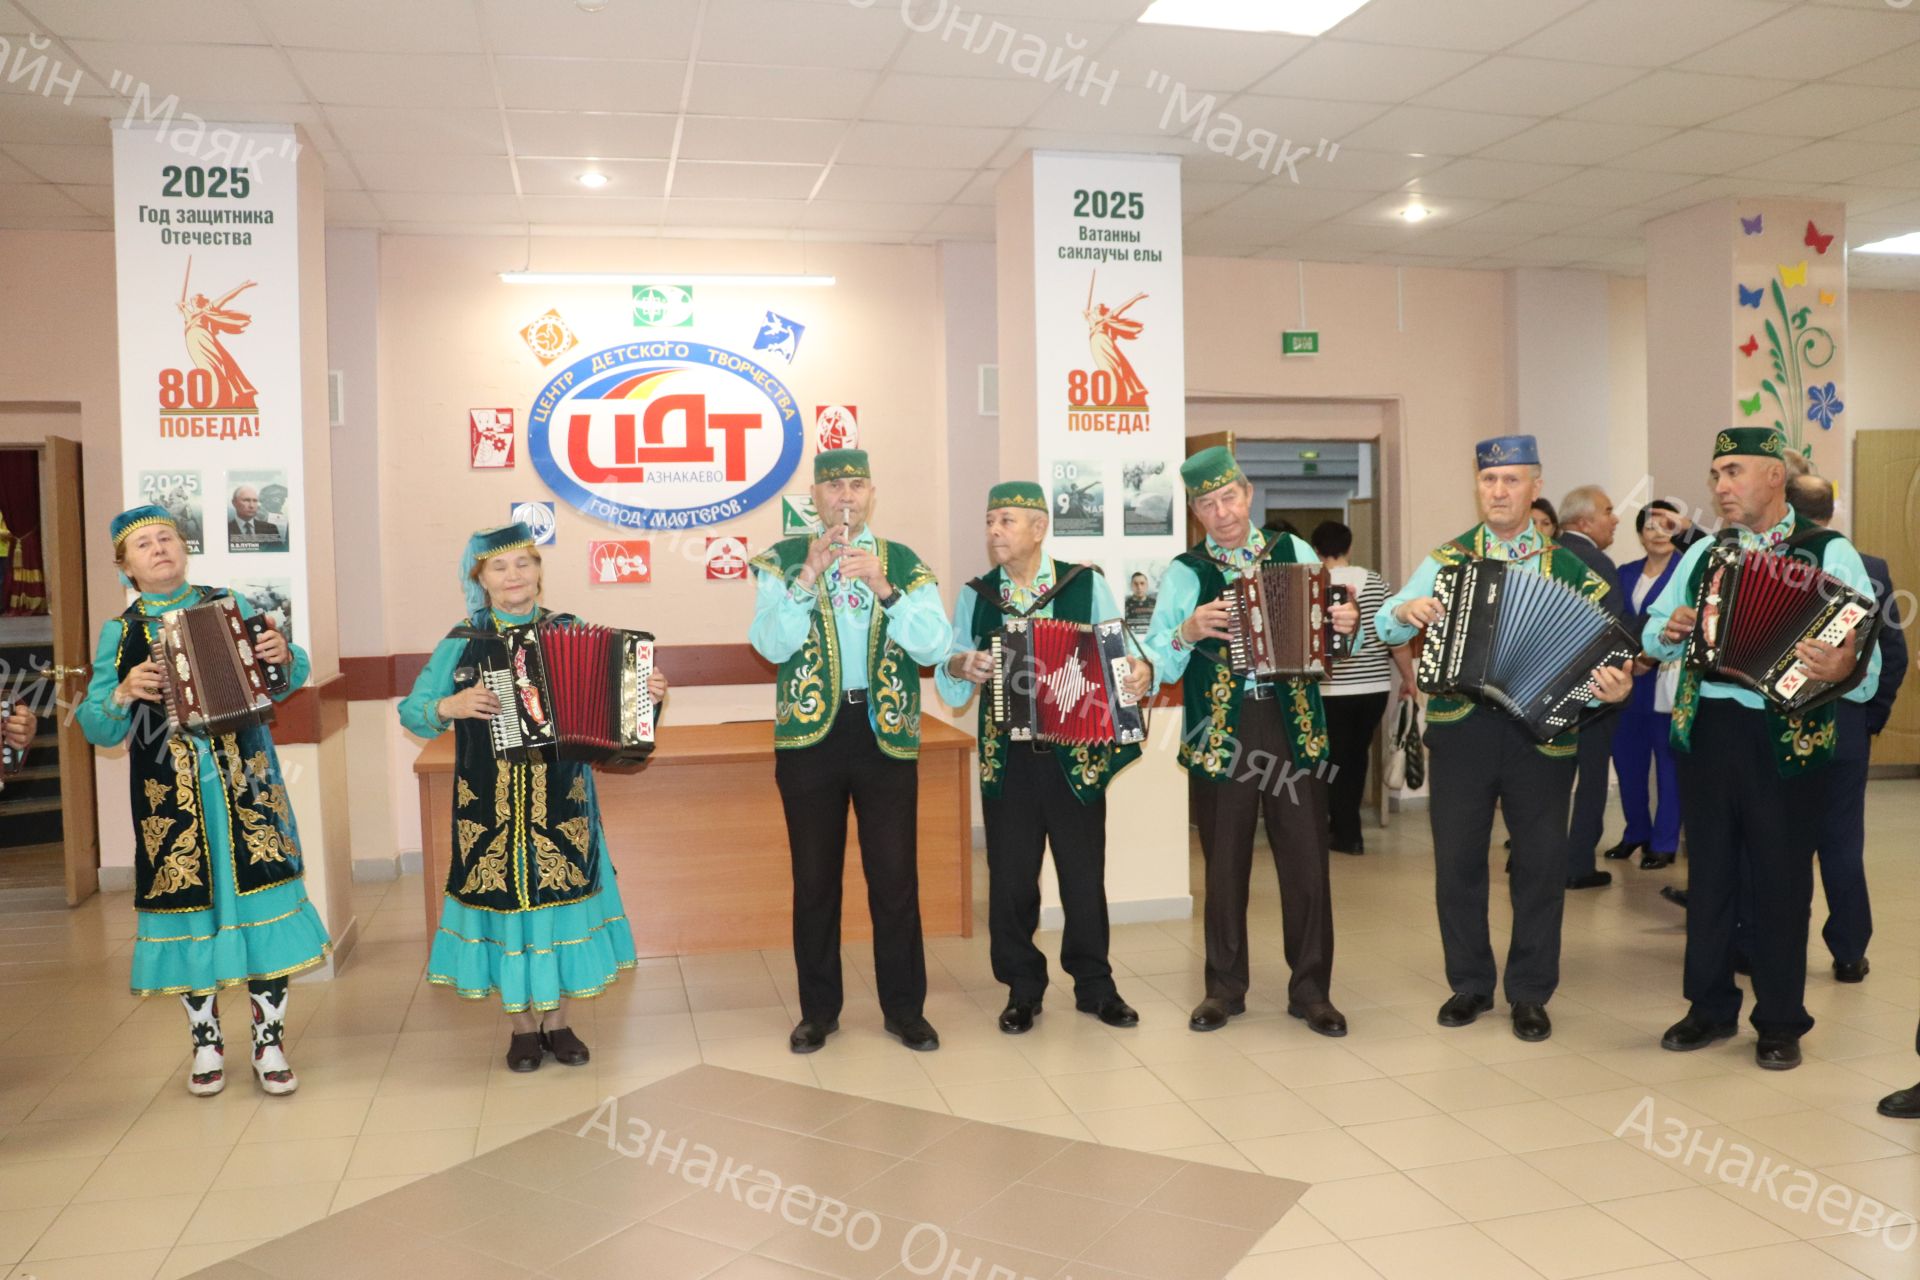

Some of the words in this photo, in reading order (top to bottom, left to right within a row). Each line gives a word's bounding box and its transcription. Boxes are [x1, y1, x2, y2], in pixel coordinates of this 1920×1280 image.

[162, 165, 250, 198] 2025
[1073, 189, 1144, 220] 2025
[139, 205, 170, 227] Год
[176, 207, 274, 225] защитника
[161, 227, 252, 247] Отечества
[1079, 225, 1141, 243] Ватанны
[1058, 246, 1129, 263] саклаучы
[1133, 248, 1162, 262] елы
[158, 368, 213, 409] 80
[534, 371, 575, 423] ЦЕНТР
[591, 342, 689, 373] ДЕТСКОГО
[708, 349, 796, 421] ТВОРЧЕСТВА
[1067, 369, 1112, 406] 80
[159, 416, 261, 441] ПОБЕДА!
[1068, 413, 1150, 435] ПОБЕДА!
[567, 394, 762, 483] ЦДТ
[646, 470, 723, 484] АЗНАКАЕВО
[1055, 464, 1077, 479] 80
[143, 474, 198, 492] 2025
[590, 499, 643, 525] ГОРОД
[1056, 493, 1071, 514] 9
